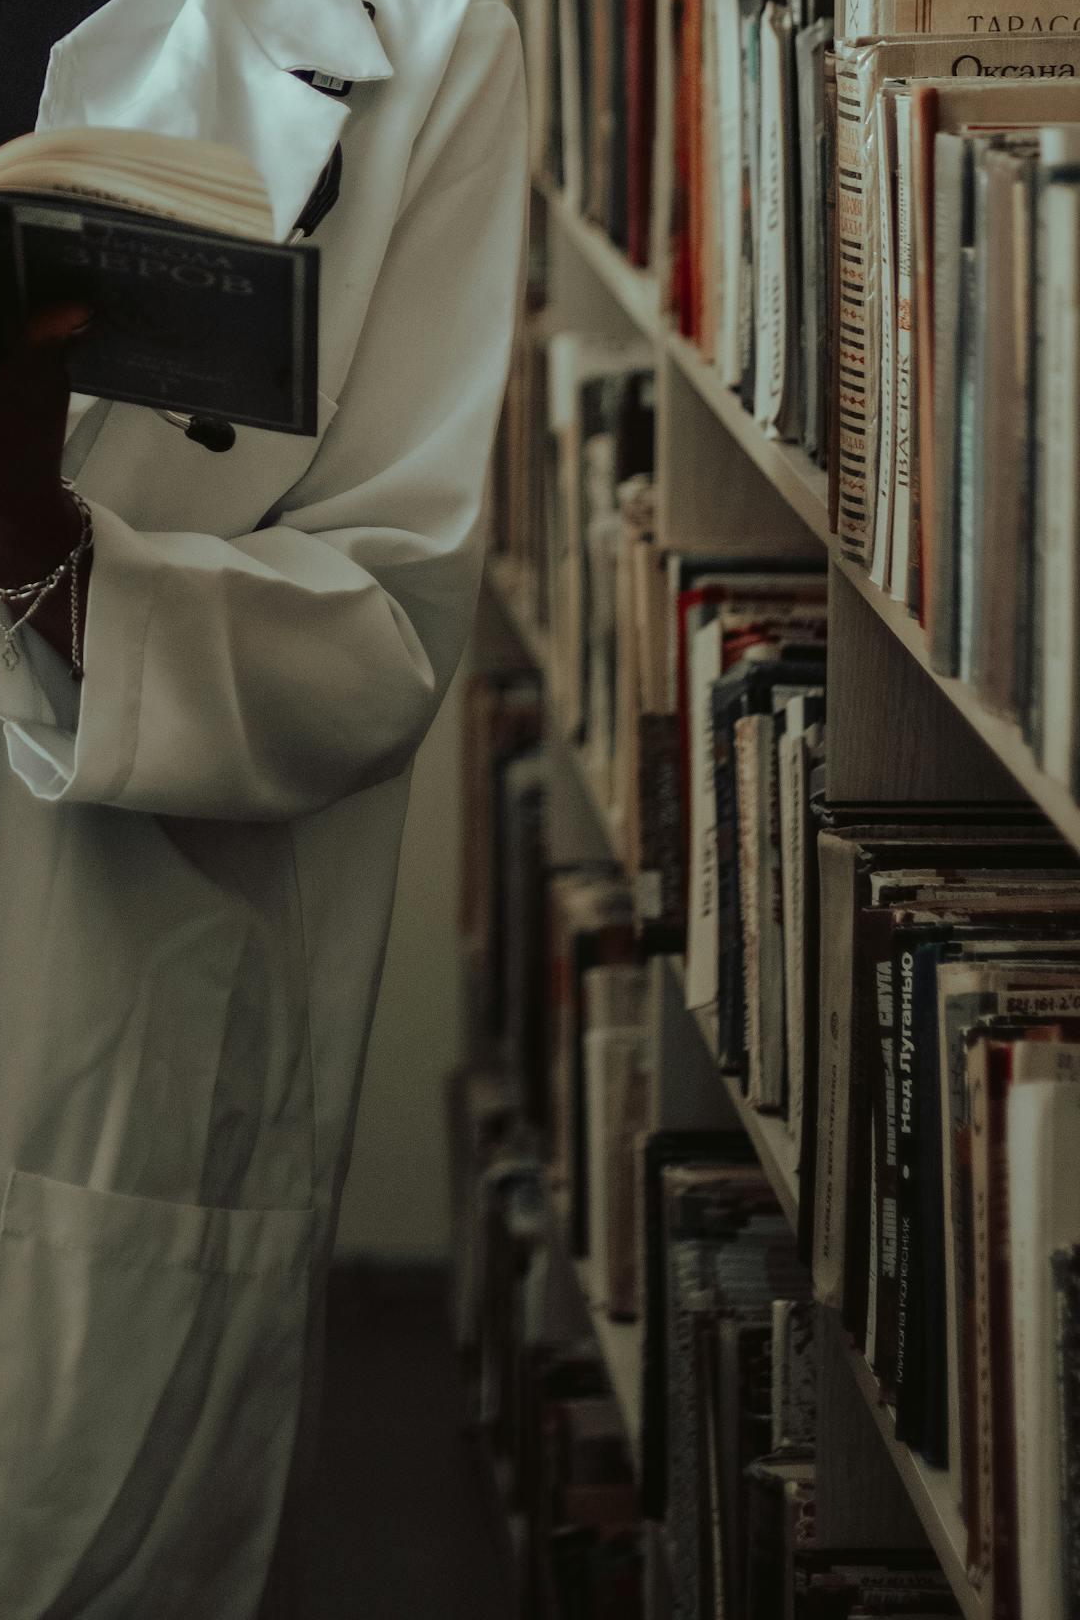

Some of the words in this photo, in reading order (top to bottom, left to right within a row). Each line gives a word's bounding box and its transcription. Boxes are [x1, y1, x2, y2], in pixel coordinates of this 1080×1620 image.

[967, 15, 1080, 32] ТАРАС
[62, 246, 255, 296] ЗЕРОВ
[899, 951, 916, 1074] Луганью
[900, 1078, 913, 1134] Над
